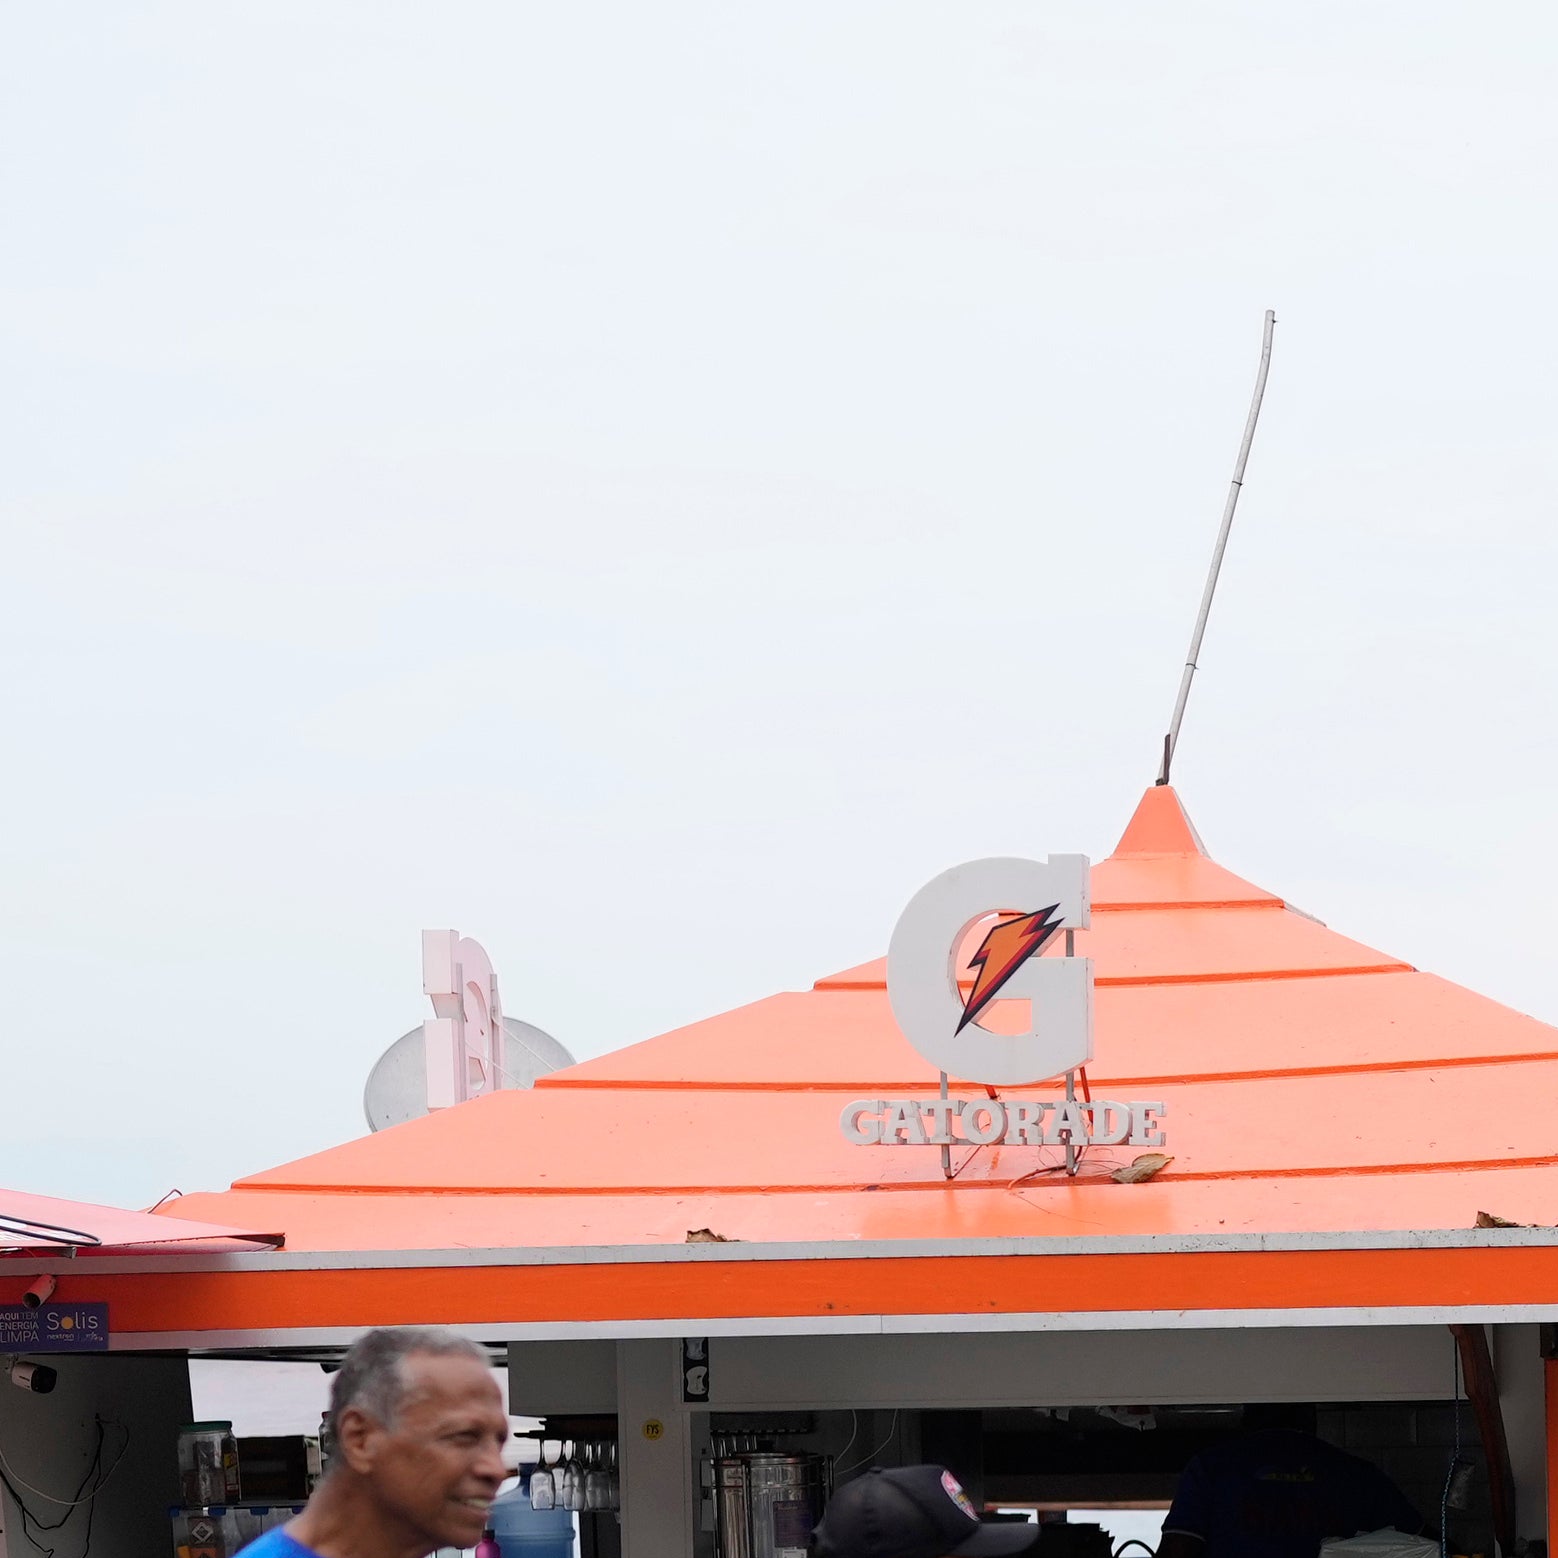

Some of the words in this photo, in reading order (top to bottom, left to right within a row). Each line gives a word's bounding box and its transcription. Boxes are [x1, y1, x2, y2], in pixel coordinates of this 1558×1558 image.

[887, 854, 1093, 1085] G
[840, 1100, 1166, 1147] GATORADE
[22, 1312, 39, 1320] TEM
